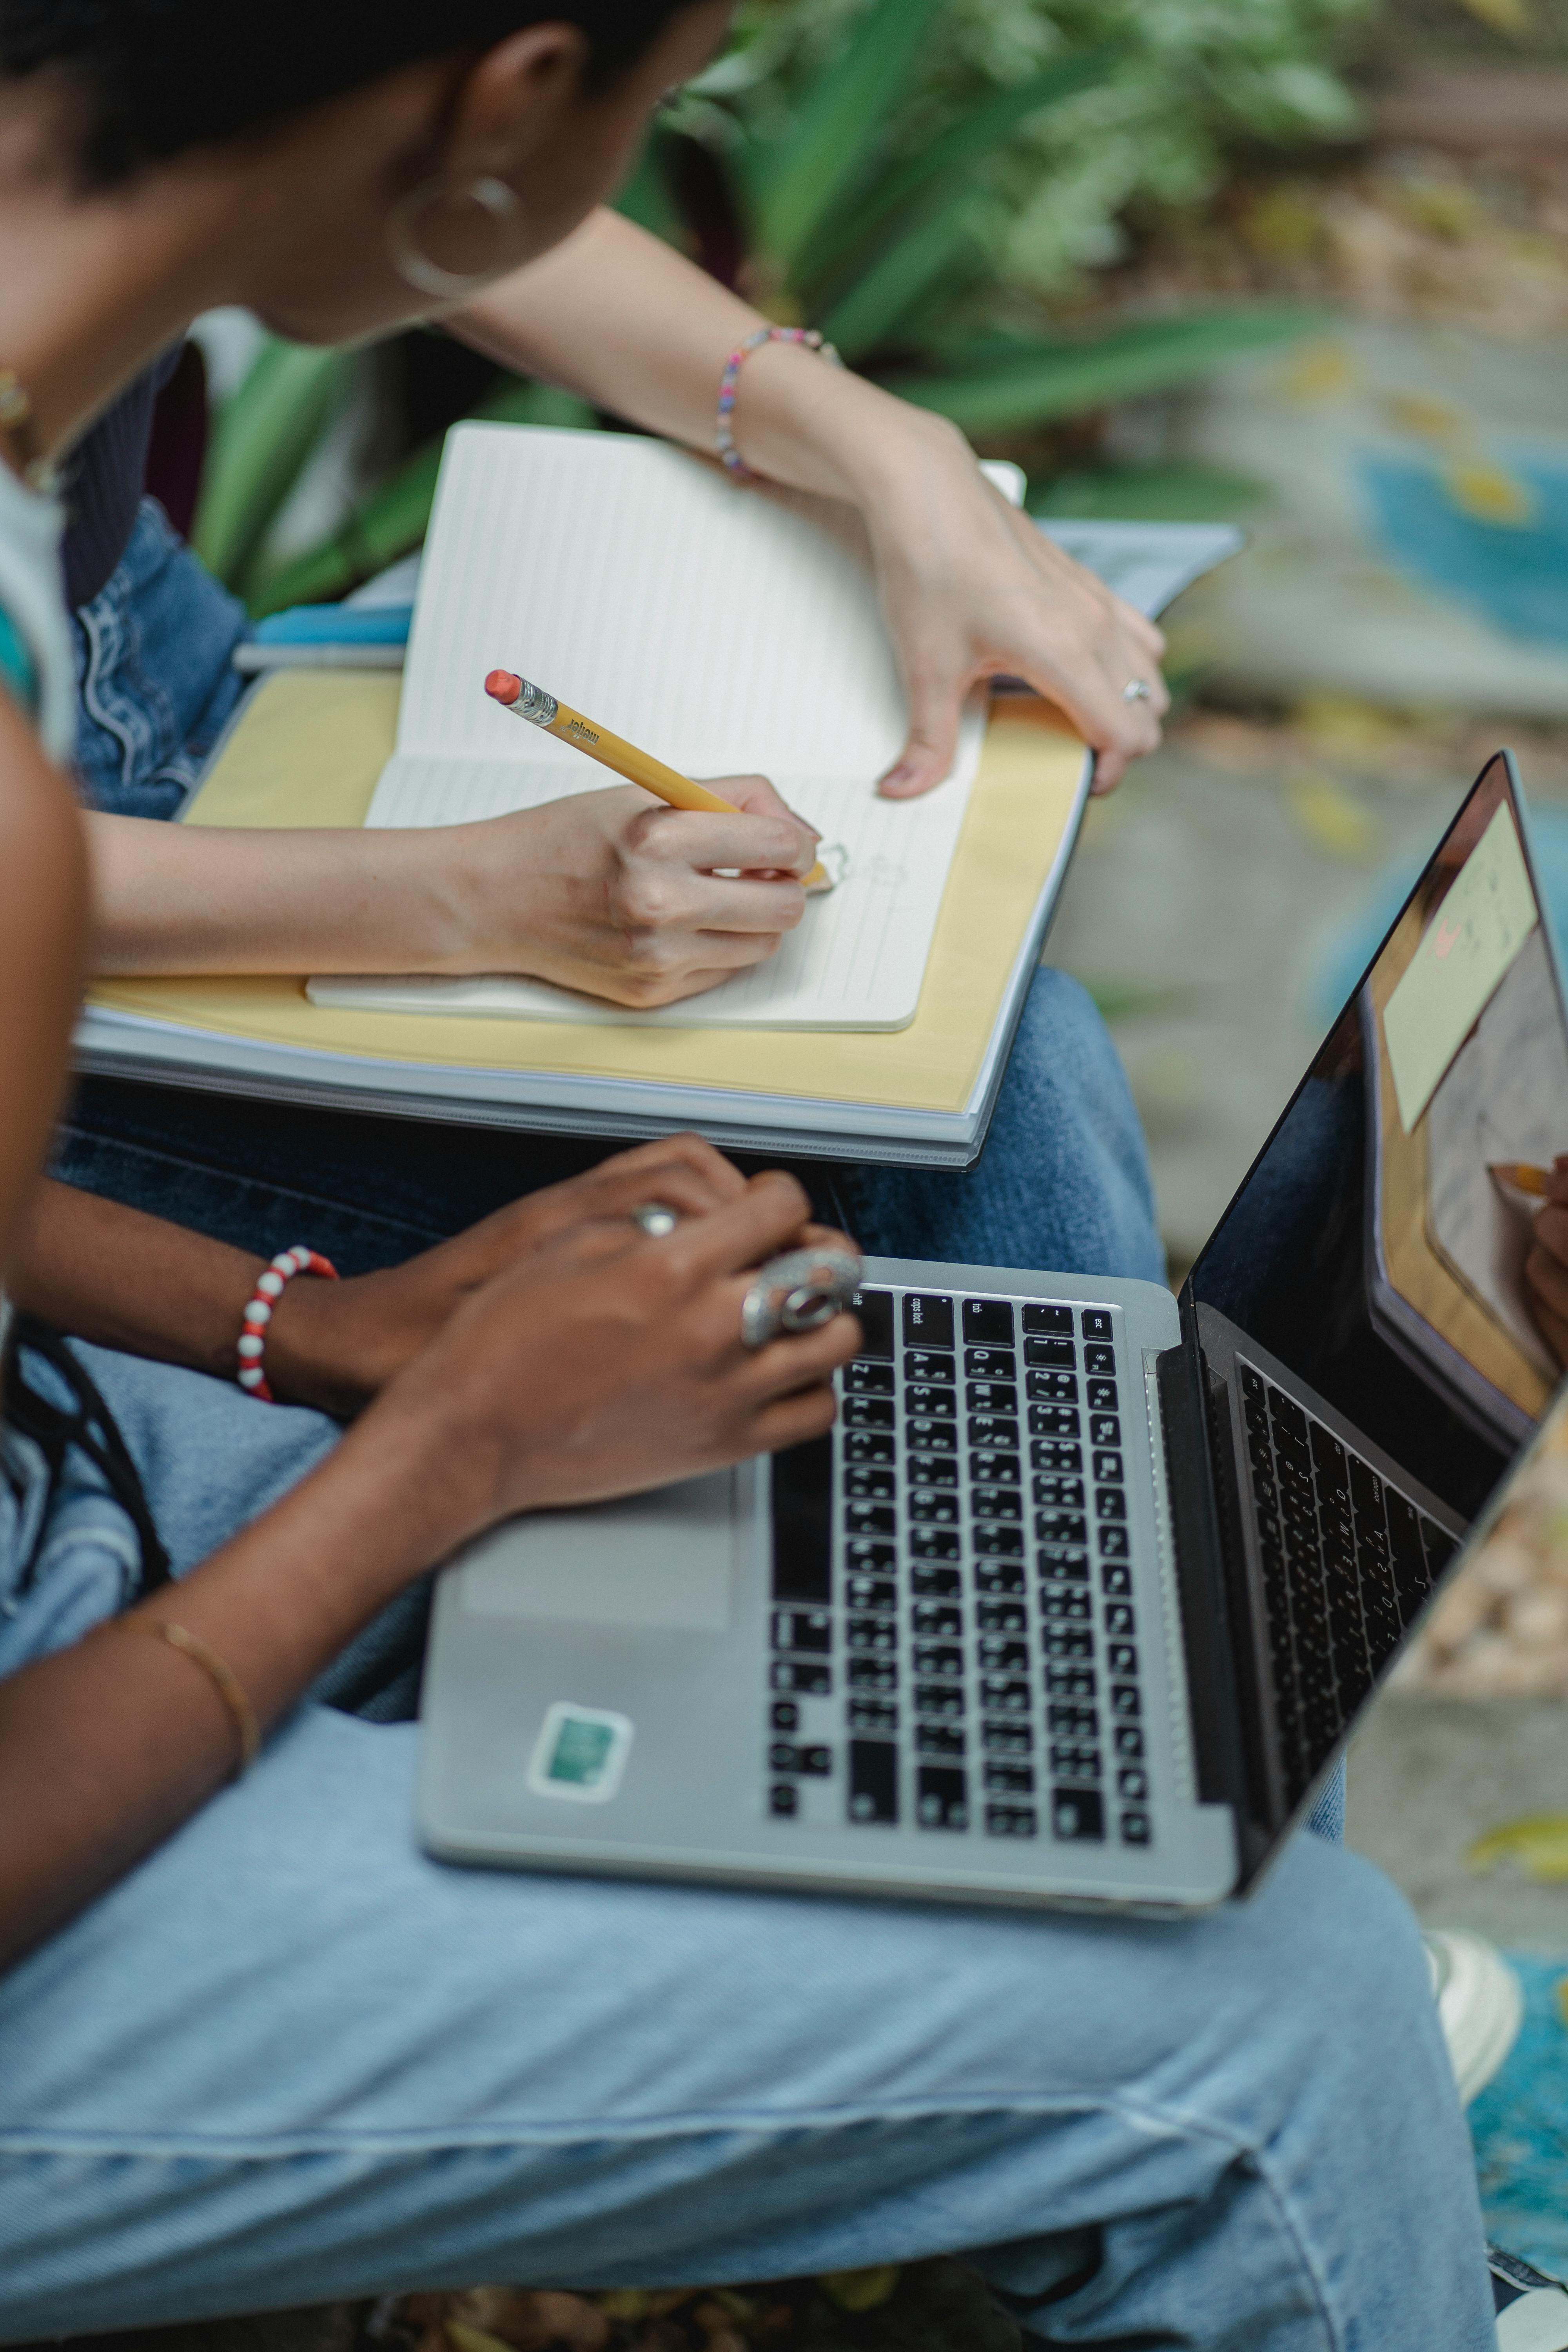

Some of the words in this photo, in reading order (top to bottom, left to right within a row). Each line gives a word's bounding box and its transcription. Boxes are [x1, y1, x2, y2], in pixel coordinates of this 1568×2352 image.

[568, 719, 599, 745] meijer
[853, 1293, 862, 1305] shift
[911, 1298, 921, 1312] caps
[973, 1304, 982, 1313] tab
[913, 1312, 923, 1324] lock
[914, 1353, 928, 1361] A
[974, 1351, 989, 1359] Q
[852, 1364, 869, 1373] Z
[1058, 1375, 1070, 1383] @
[914, 1387, 930, 1395] S
[975, 1385, 990, 1396] W
[853, 1399, 869, 1408] X
